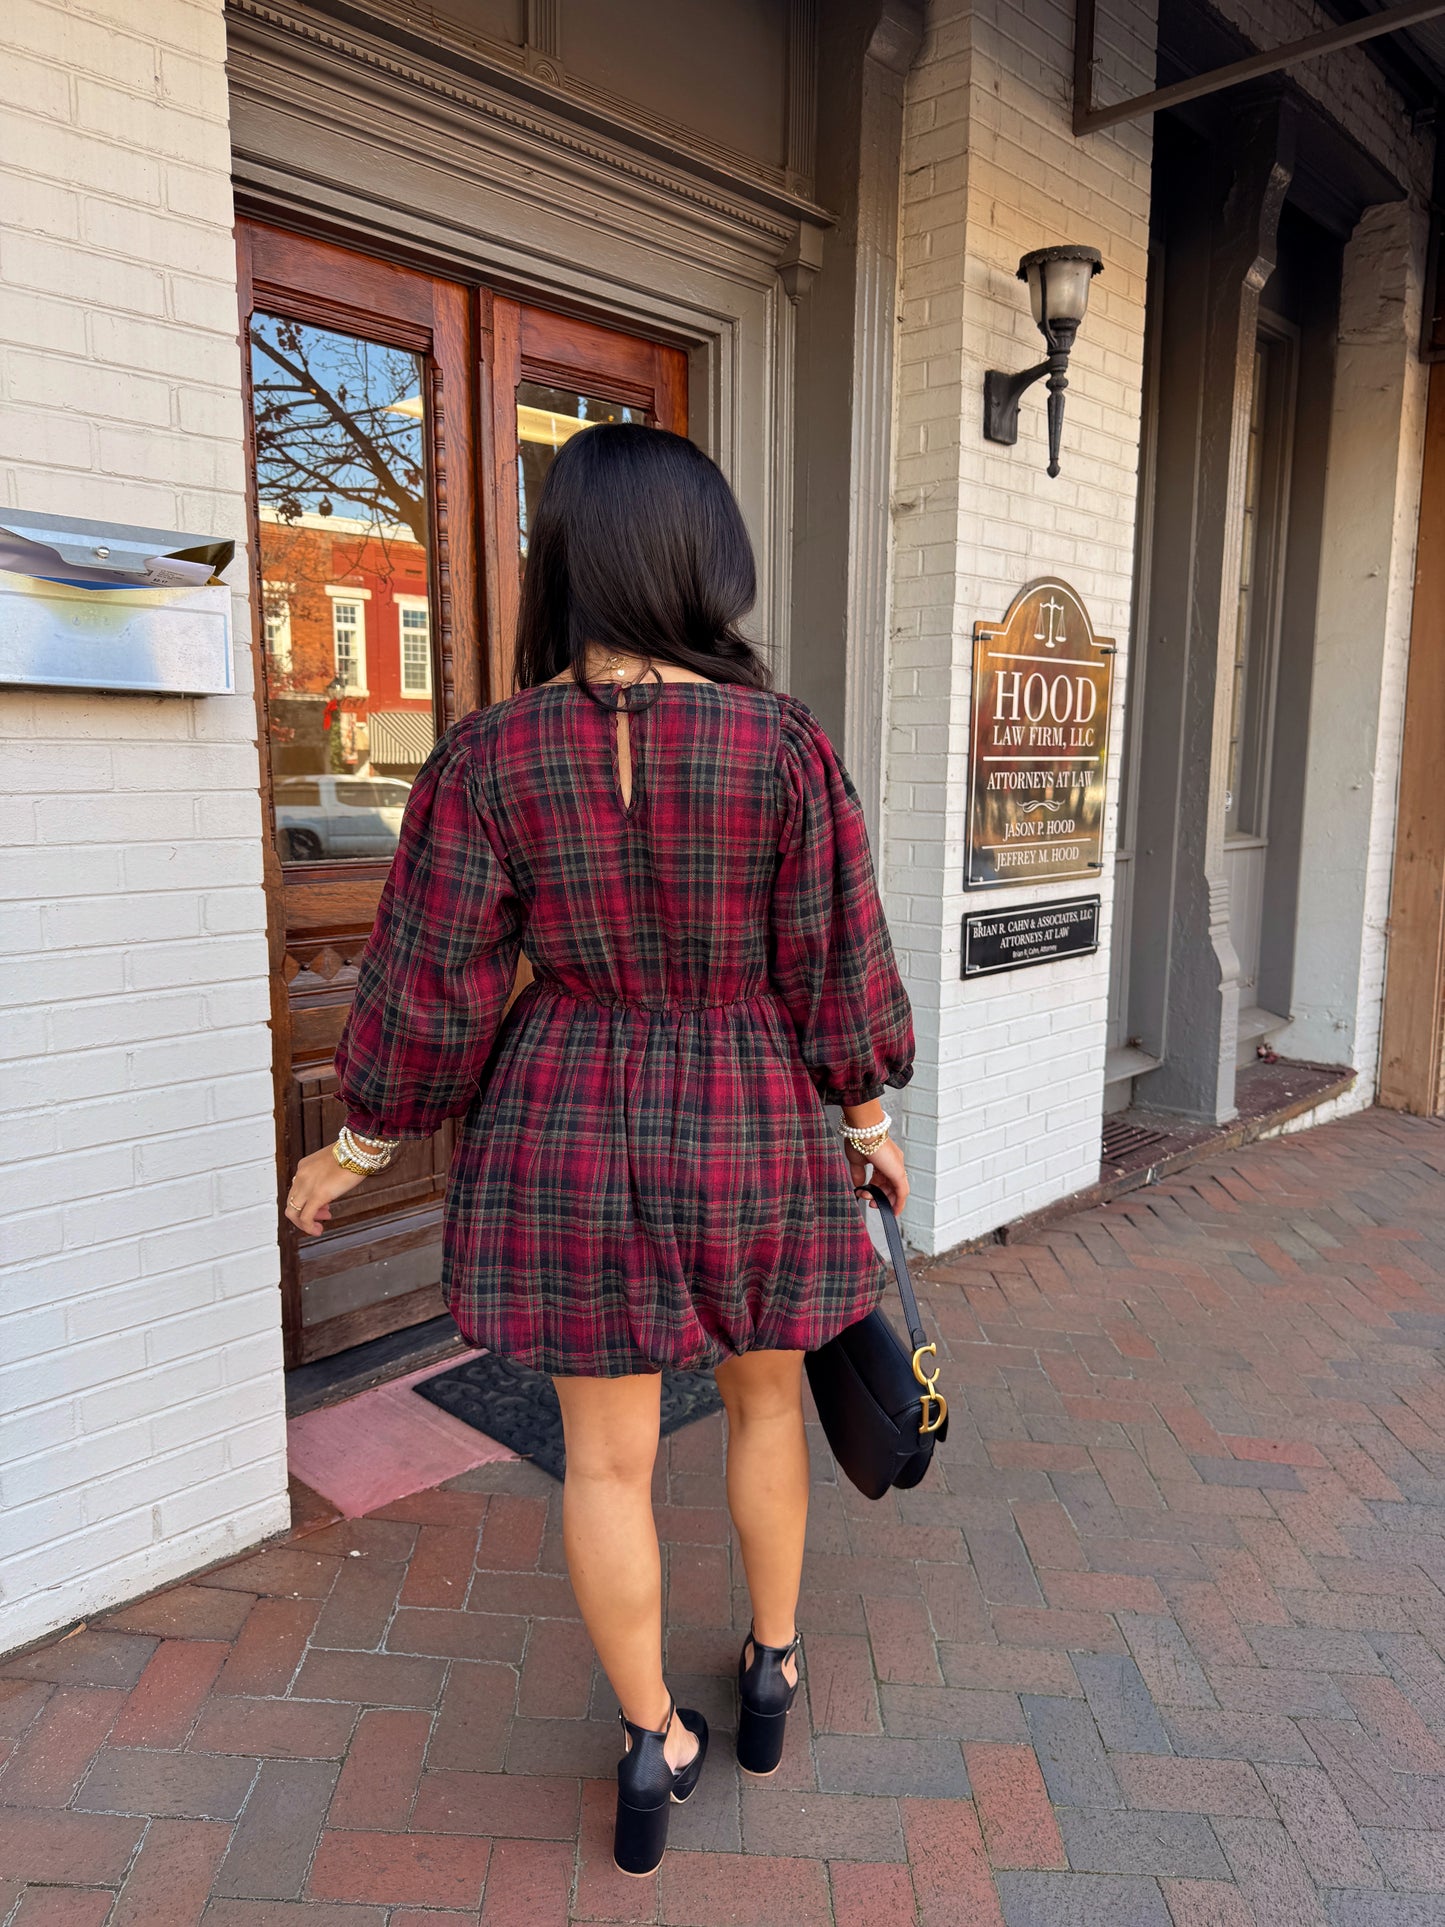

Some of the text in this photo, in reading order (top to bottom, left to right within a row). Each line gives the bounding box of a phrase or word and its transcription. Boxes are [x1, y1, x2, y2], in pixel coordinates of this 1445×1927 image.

[992, 670, 1097, 723] HOOD
[992, 725, 1095, 750] LAW FIRM, LLC
[987, 770, 1094, 790] ATTORNEYS AT LAW
[1002, 819, 1075, 842] JASON P. HOOD
[994, 846, 1080, 872] JEFFREY M. HOOD
[973, 923, 998, 938] BRIAN
[1007, 918, 1030, 933] CAHN
[1030, 918, 1036, 929] &
[1080, 908, 1093, 921] LLC
[999, 926, 1070, 949] ATTORNEYS AT LAW
